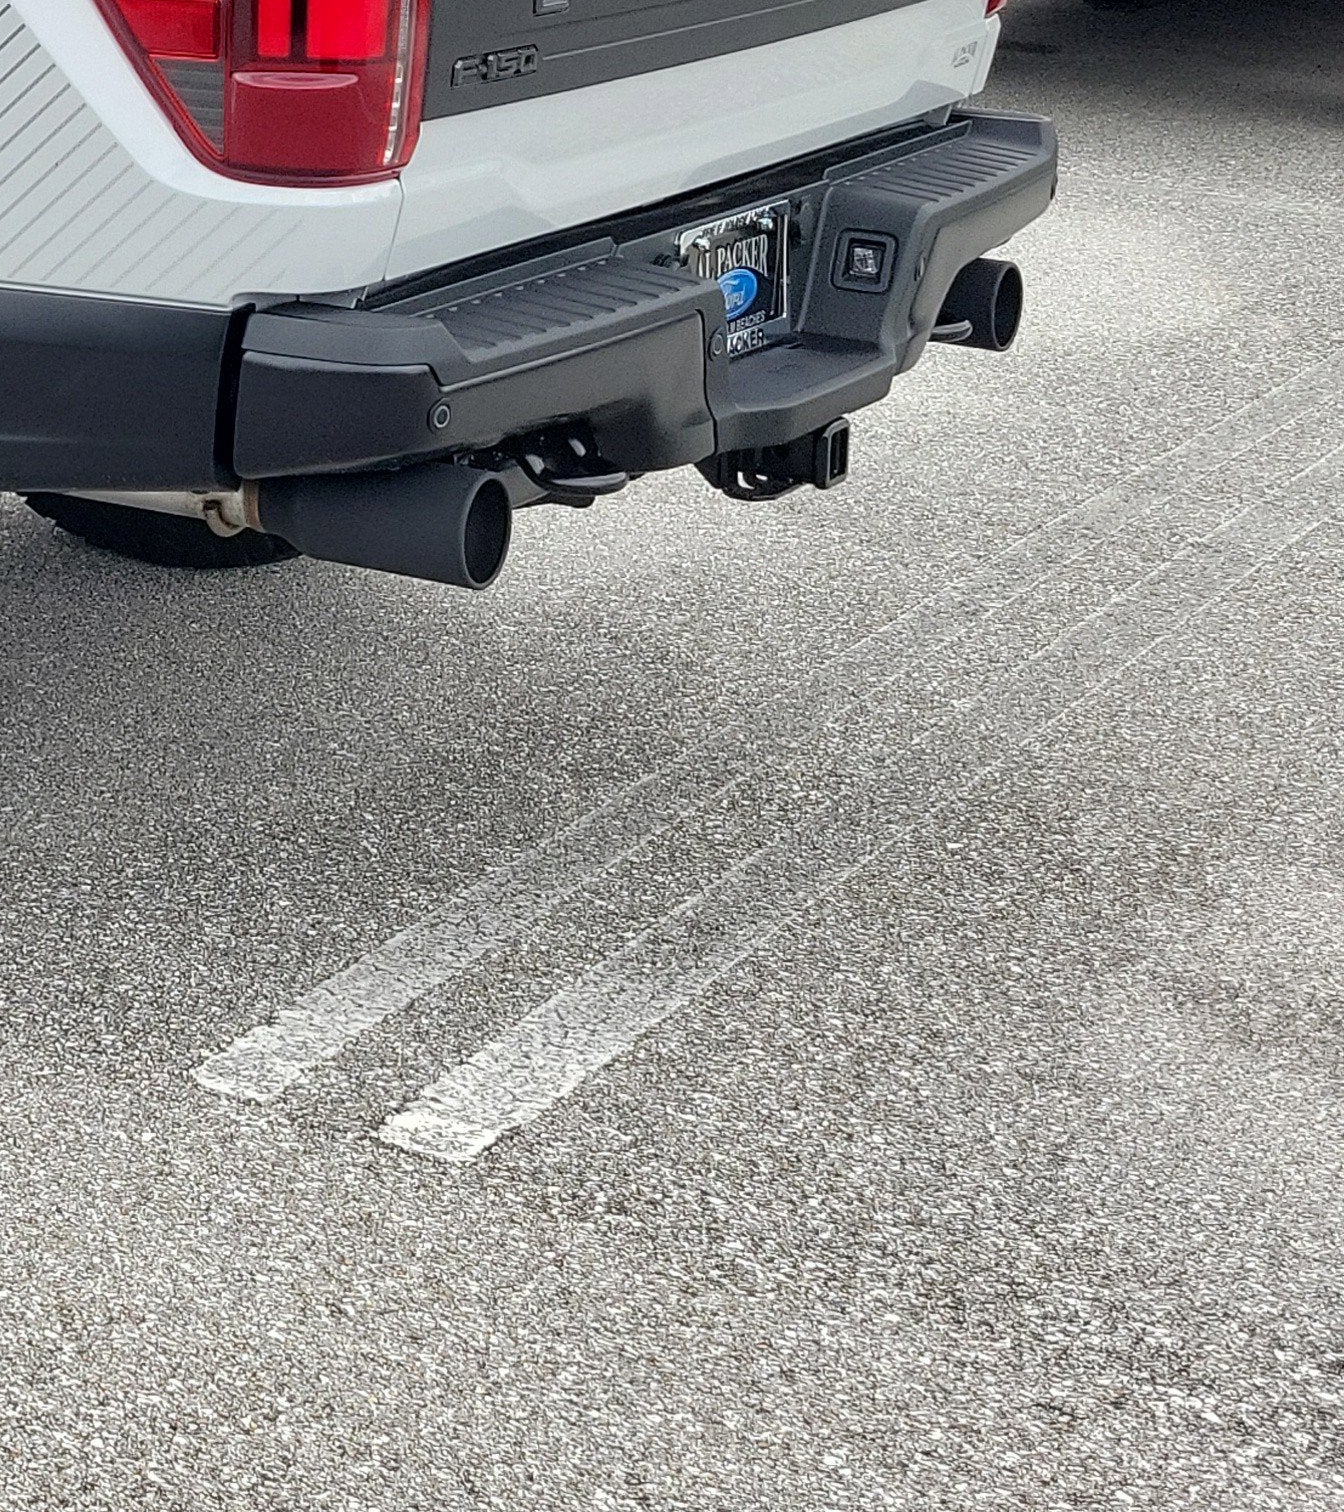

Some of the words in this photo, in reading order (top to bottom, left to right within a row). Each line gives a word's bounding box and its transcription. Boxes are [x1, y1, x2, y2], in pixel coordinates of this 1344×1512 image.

[450, 44, 539, 88] F-150
[716, 233, 769, 278] PACKER
[727, 328, 765, 355] ACKER
